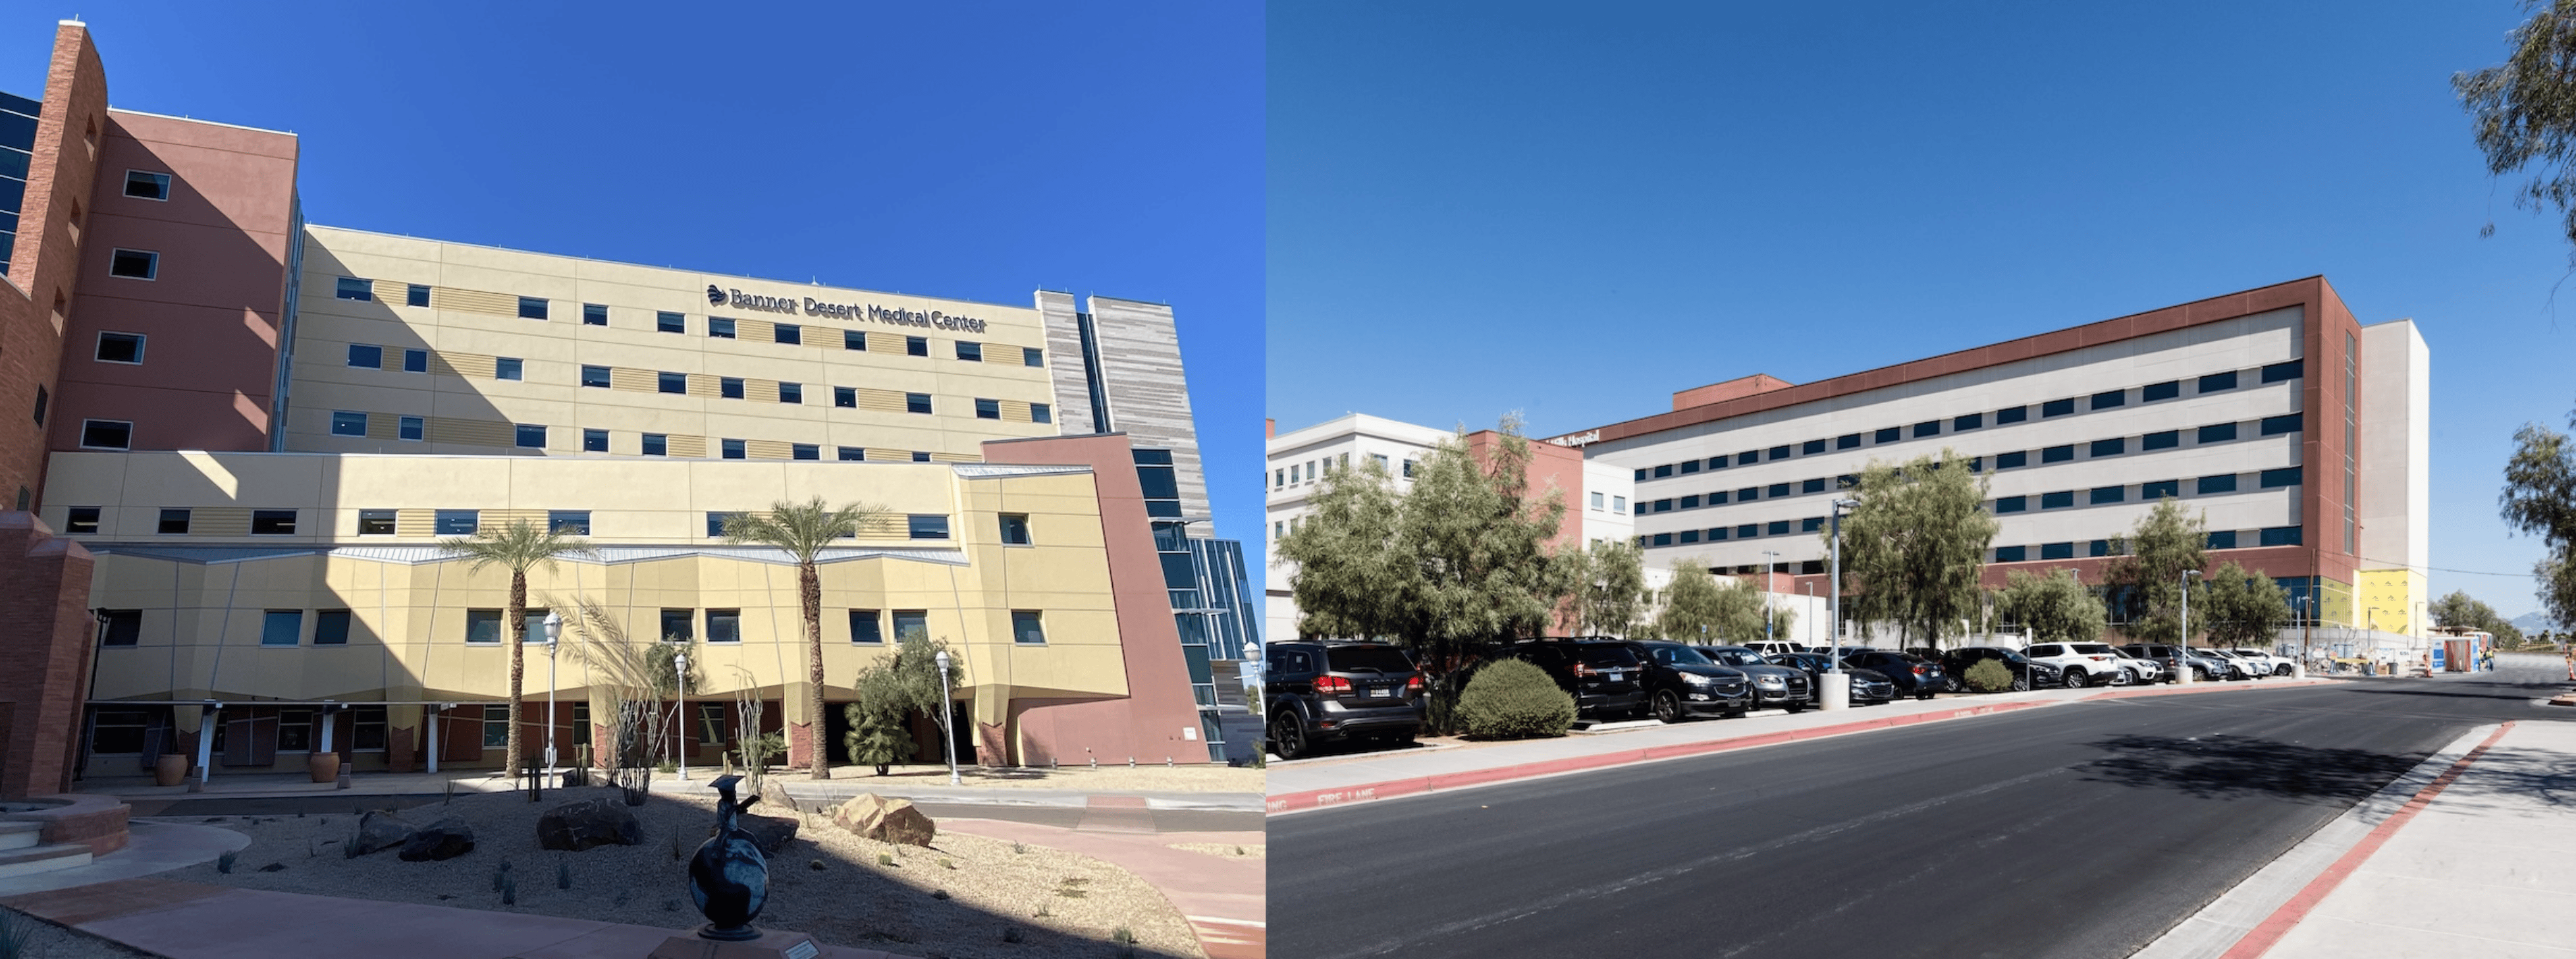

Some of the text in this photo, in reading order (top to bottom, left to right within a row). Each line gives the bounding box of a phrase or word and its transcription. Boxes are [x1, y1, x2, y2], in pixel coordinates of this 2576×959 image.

[729, 288, 986, 332] Banner Desert Medical Center
[1568, 429, 1599, 447] Hospital
[1266, 788, 1375, 813] ING FIRE LANE
